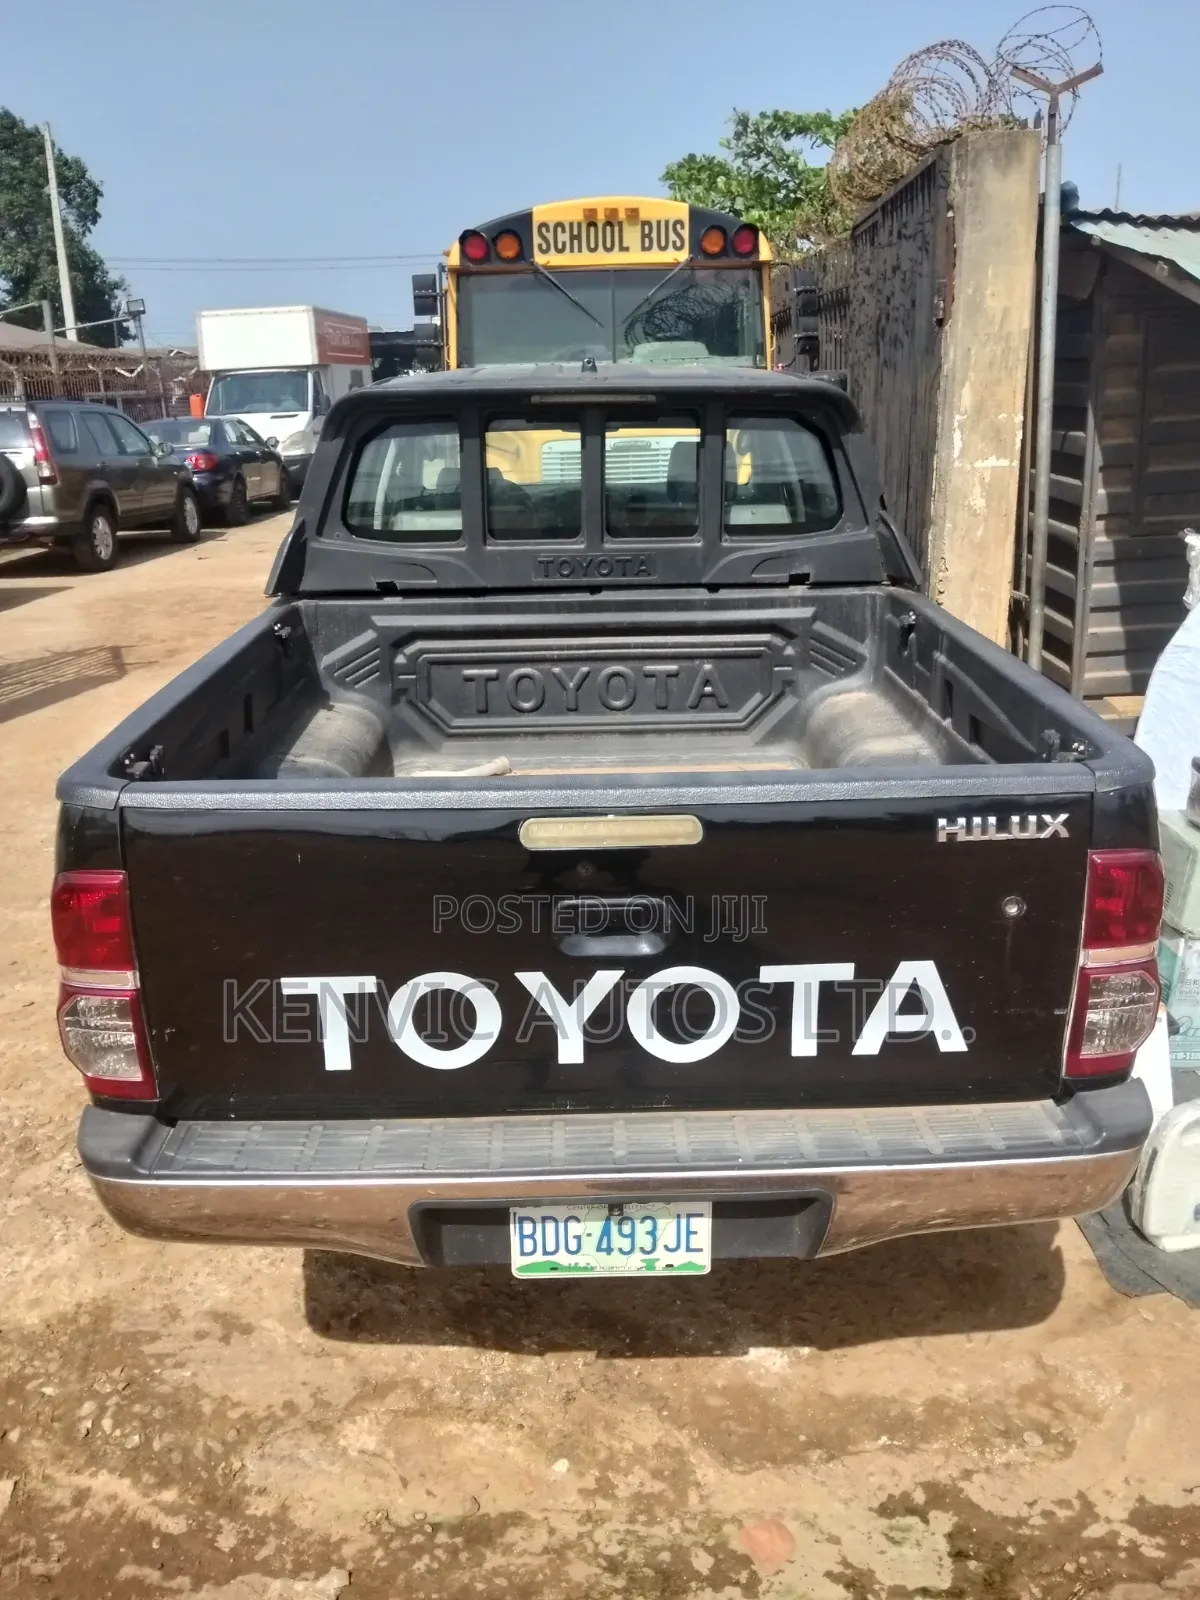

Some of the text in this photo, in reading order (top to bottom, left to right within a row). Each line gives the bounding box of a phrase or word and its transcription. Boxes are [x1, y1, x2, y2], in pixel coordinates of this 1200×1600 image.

[537, 219, 685, 254] SCHOOL BUS
[537, 556, 651, 578] TOYOTA
[461, 664, 729, 713] TOYOTA
[936, 813, 1070, 842] HILUX
[280, 960, 969, 1071] TOYOTA
